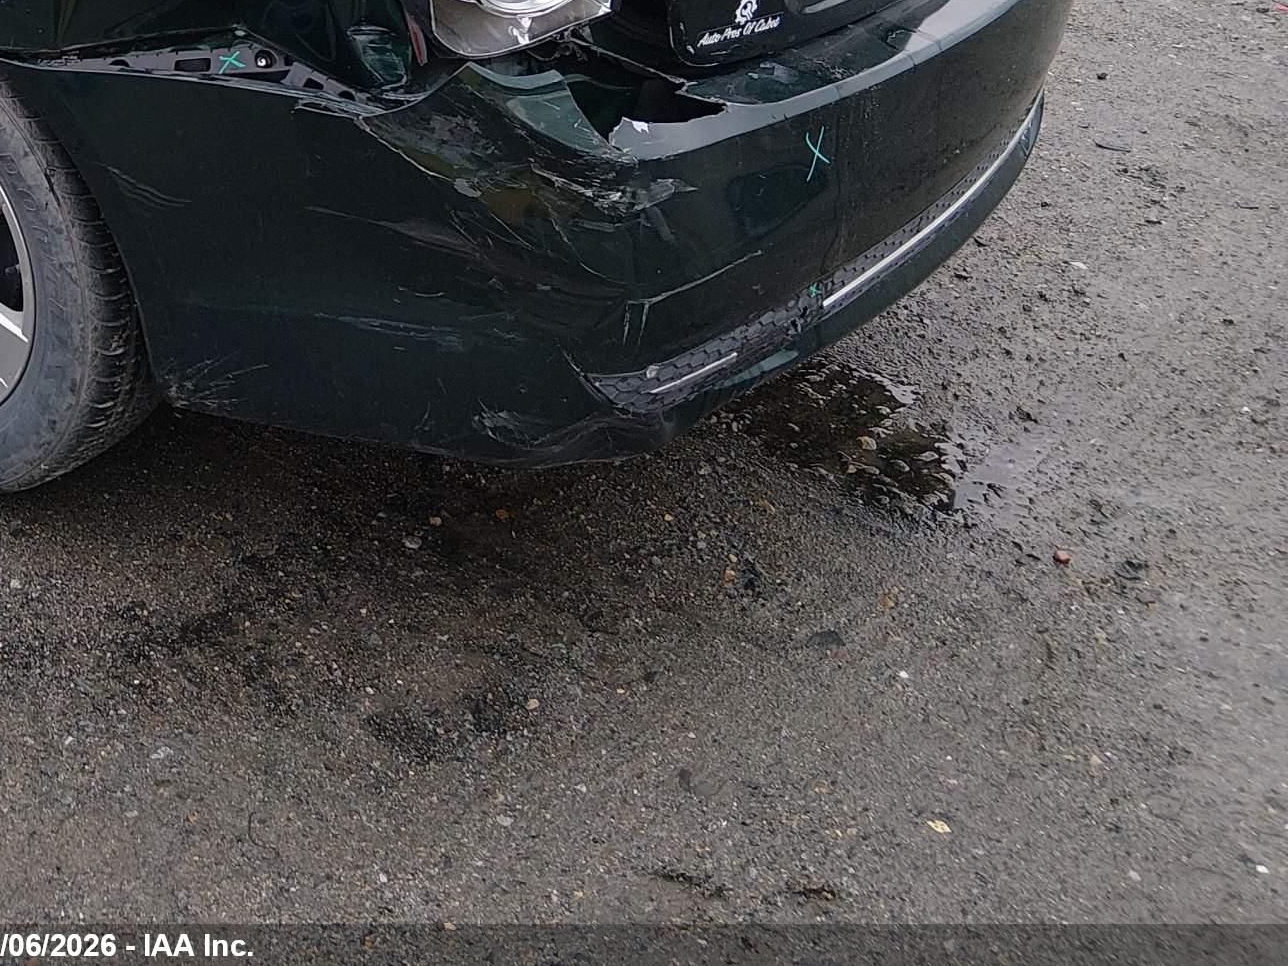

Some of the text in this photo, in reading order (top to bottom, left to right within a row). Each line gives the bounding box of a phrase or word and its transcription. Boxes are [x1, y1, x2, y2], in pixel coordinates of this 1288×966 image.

[697, 16, 781, 48] Auto Pros Of Cabot
